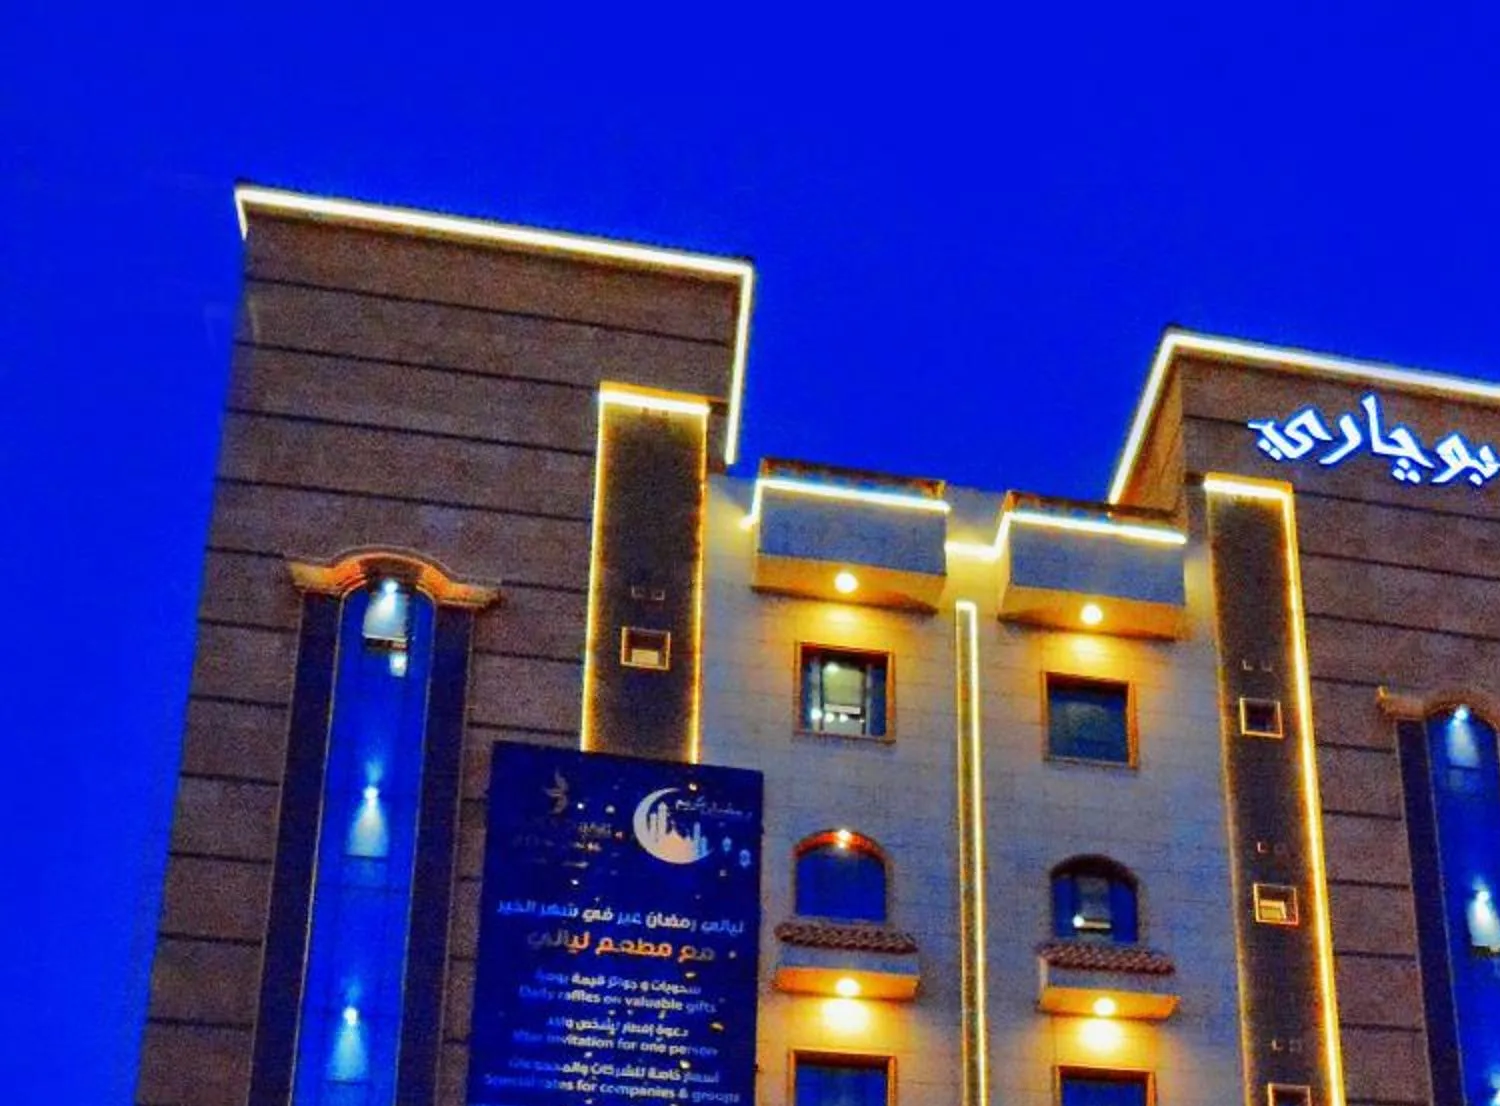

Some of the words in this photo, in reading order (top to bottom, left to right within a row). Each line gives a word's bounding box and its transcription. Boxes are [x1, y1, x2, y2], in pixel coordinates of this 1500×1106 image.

[539, 902, 578, 917] شهر
[645, 913, 697, 932] رمضان
[595, 937, 672, 958] مطعم
[677, 944, 715, 963] مع
[558, 988, 600, 1003] raffles
[625, 995, 683, 1011] valuable
[685, 1001, 718, 1015] gifts
[546, 1032, 614, 1048] invitation
[617, 1037, 637, 1049] for
[640, 1042, 666, 1053] one
[669, 1044, 719, 1057] person
[576, 1079, 596, 1092] for
[600, 1083, 674, 1099] companies
[692, 1090, 740, 1104] groups
